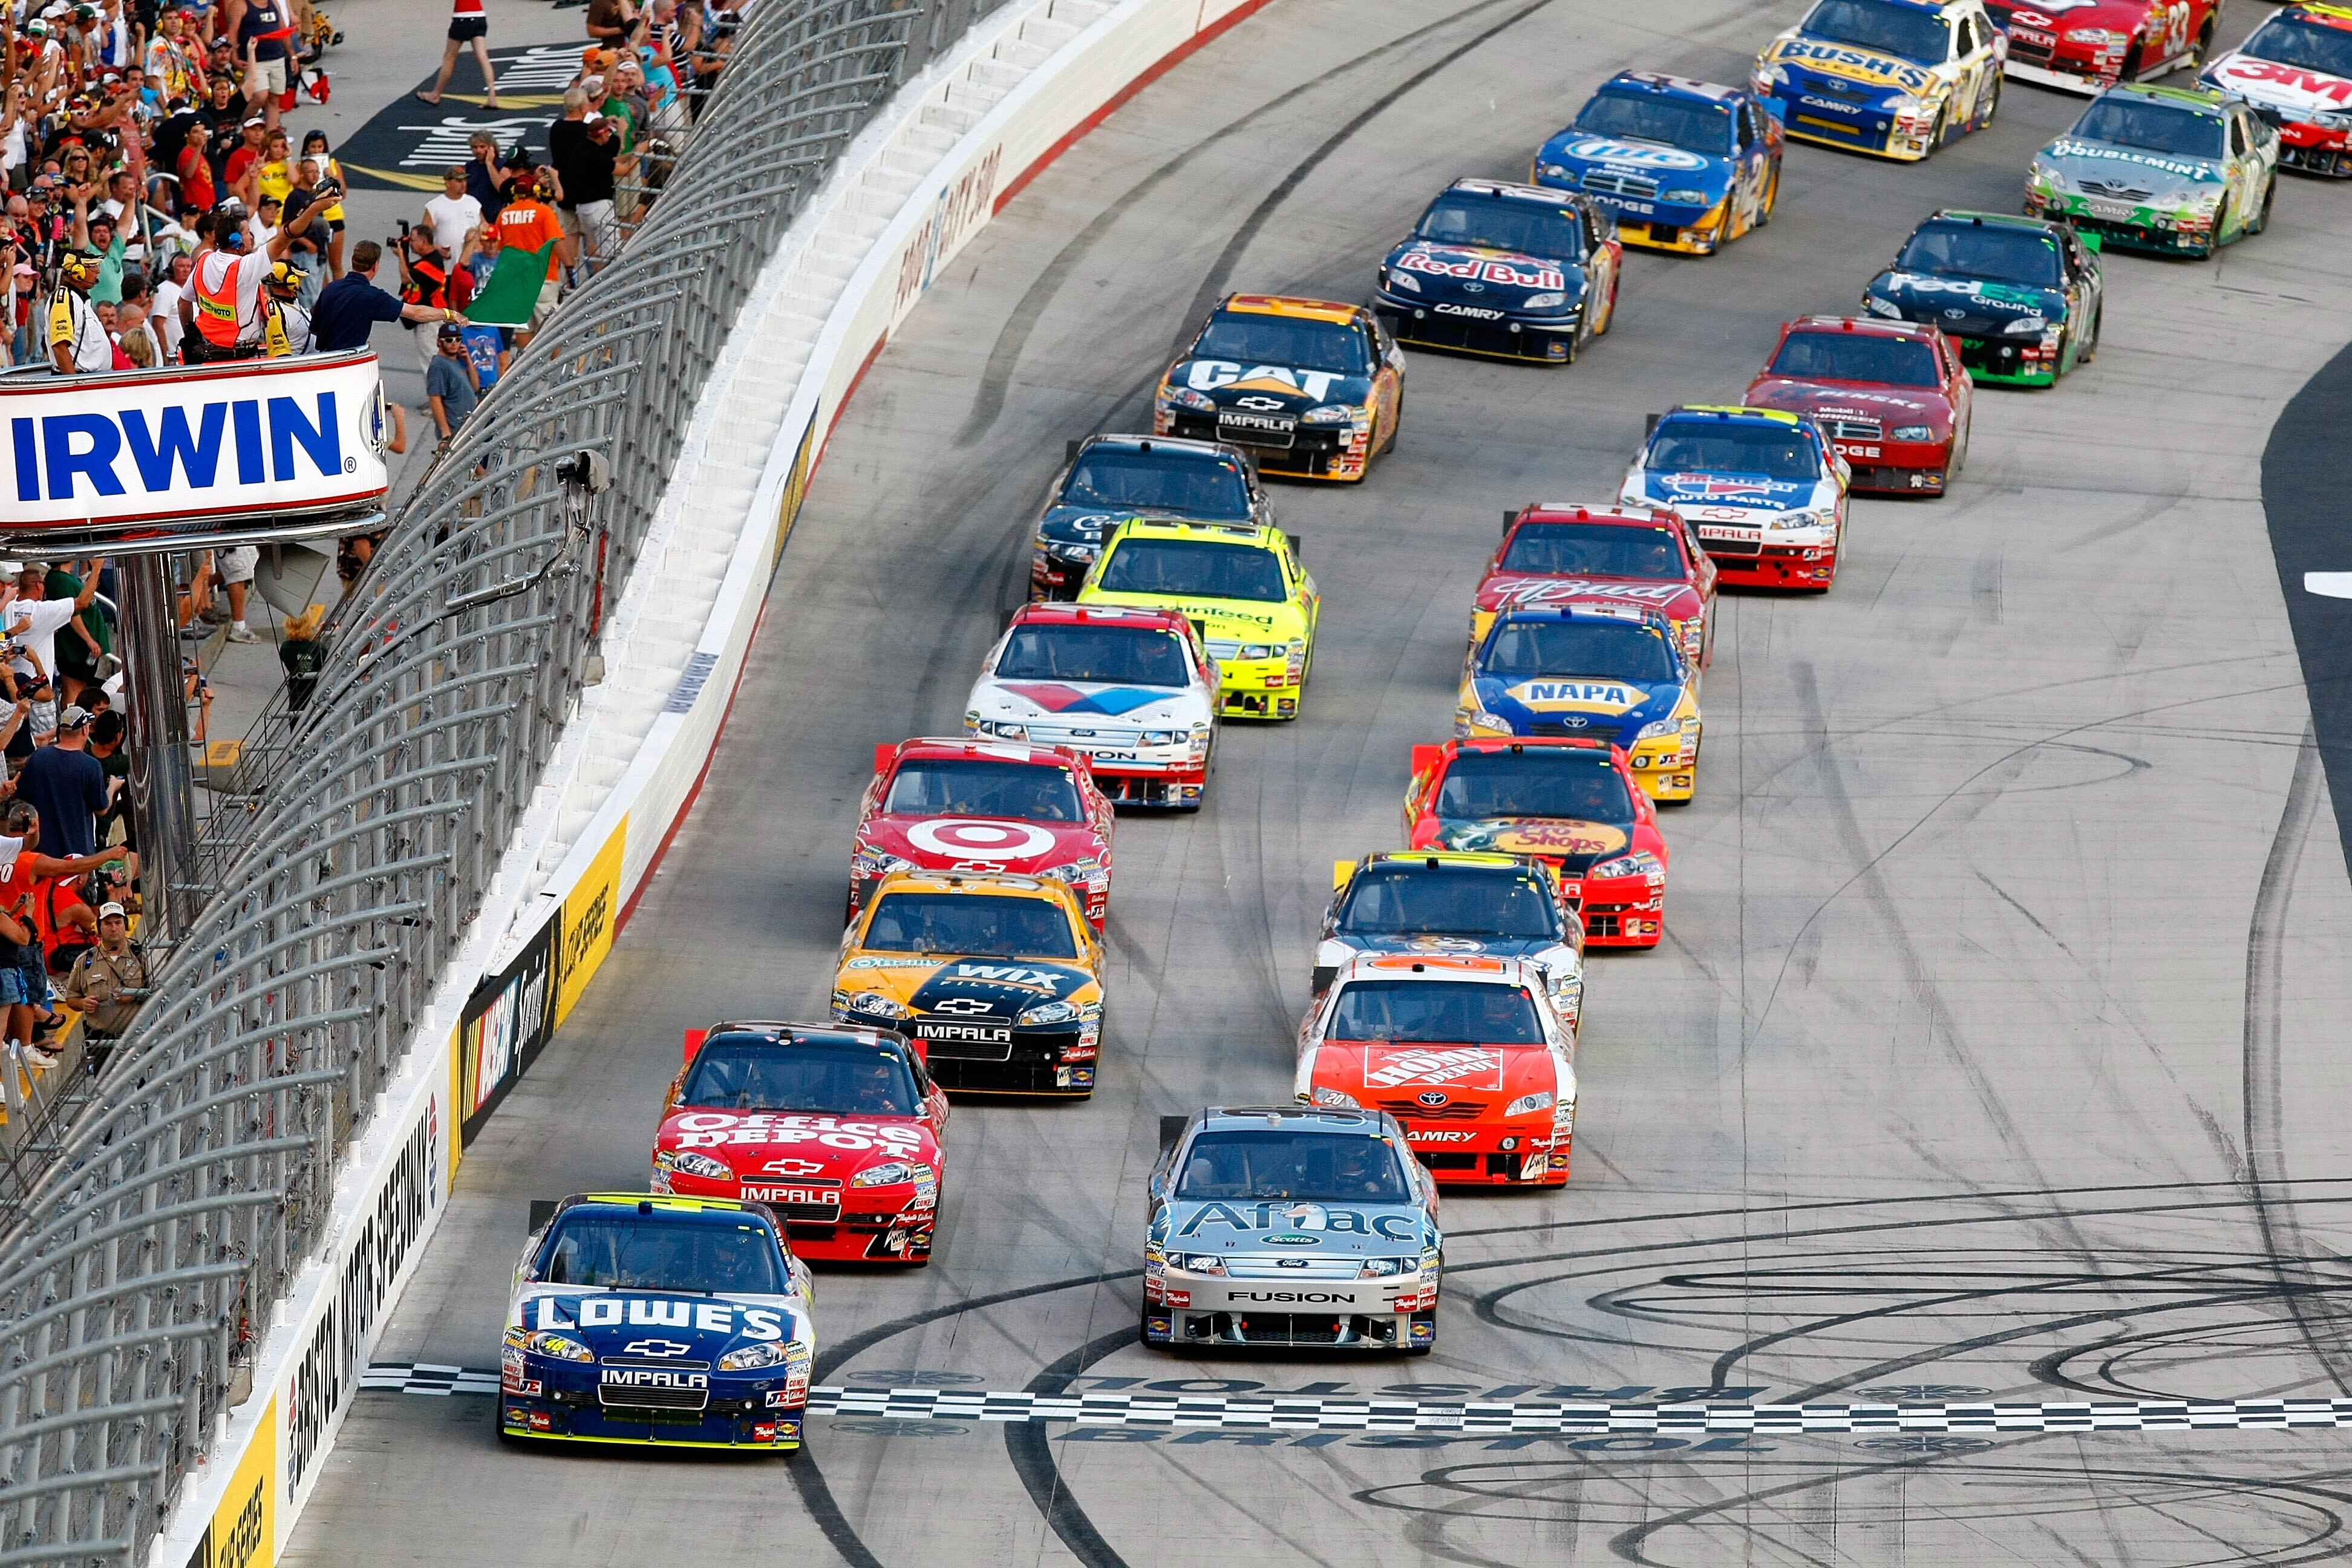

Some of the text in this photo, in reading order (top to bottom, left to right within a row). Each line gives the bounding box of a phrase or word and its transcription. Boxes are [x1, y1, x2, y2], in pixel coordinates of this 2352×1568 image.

[2164, 1, 2190, 57] 33
[1778, 42, 1929, 88] BUSH'S
[1815, 61, 1876, 80] BEST
[2227, 59, 2352, 102] 3M
[1799, 95, 1863, 115] CAMRY
[2052, 144, 2210, 181] DOUBLEMINT
[501, 209, 536, 226] STAFF
[2079, 201, 2139, 217] CAMRY
[1397, 252, 1564, 290] Red Bull
[1888, 273, 2043, 308] FedEx
[1434, 303, 1505, 320] CAMRY
[1970, 295, 2042, 317] Ground
[1187, 361, 1345, 402] CAT
[1218, 414, 1295, 431] IMPALA
[11, 391, 342, 501] IRWIN
[1724, 495, 1785, 510] PARTS
[1494, 578, 1681, 603] Bud
[1531, 684, 1627, 704] NAPA
[1480, 714, 1500, 727] 56
[1514, 817, 1586, 828] Bass
[1515, 832, 1605, 851] Shops
[958, 964, 1065, 990] WIX
[939, 980, 1051, 999] FILTERS
[514, 947, 548, 1077] Sprint
[863, 999, 882, 1013] 39
[917, 1025, 1011, 1042] IMPALA
[1379, 1048, 1436, 1062] THE
[1367, 1047, 1502, 1085] HOME
[1418, 1059, 1500, 1084] DEPOT
[1324, 1093, 1346, 1105] 20
[677, 1113, 923, 1145] Office
[1406, 1131, 1477, 1143] AMRY
[675, 1128, 921, 1159] DEPOT
[914, 1175, 934, 1184] MOOG
[740, 1187, 840, 1204] IMPALA
[1269, 1235, 1314, 1244] Scotts
[1189, 1258, 1210, 1269] 99
[1282, 1259, 1304, 1267] Ford
[1420, 1272, 1439, 1284] MAHLE
[296, 1106, 428, 1487] BRISTOL MOTOR SPEEDWAY
[1228, 1292, 1356, 1304] FUSION
[537, 1298, 783, 1341] LOWE'S
[544, 1339, 567, 1352] 48
[788, 1353, 808, 1363] MOOG
[601, 1370, 708, 1388] IMPALA
[787, 1364, 809, 1376] MAHLE
[519, 1379, 540, 1392] JE
[1077, 1376, 1771, 1400] BRISTOL
[767, 1392, 788, 1406] JE
[1050, 1427, 1779, 1452] BRISTOL
[236, 1474, 264, 1567] SERIES
